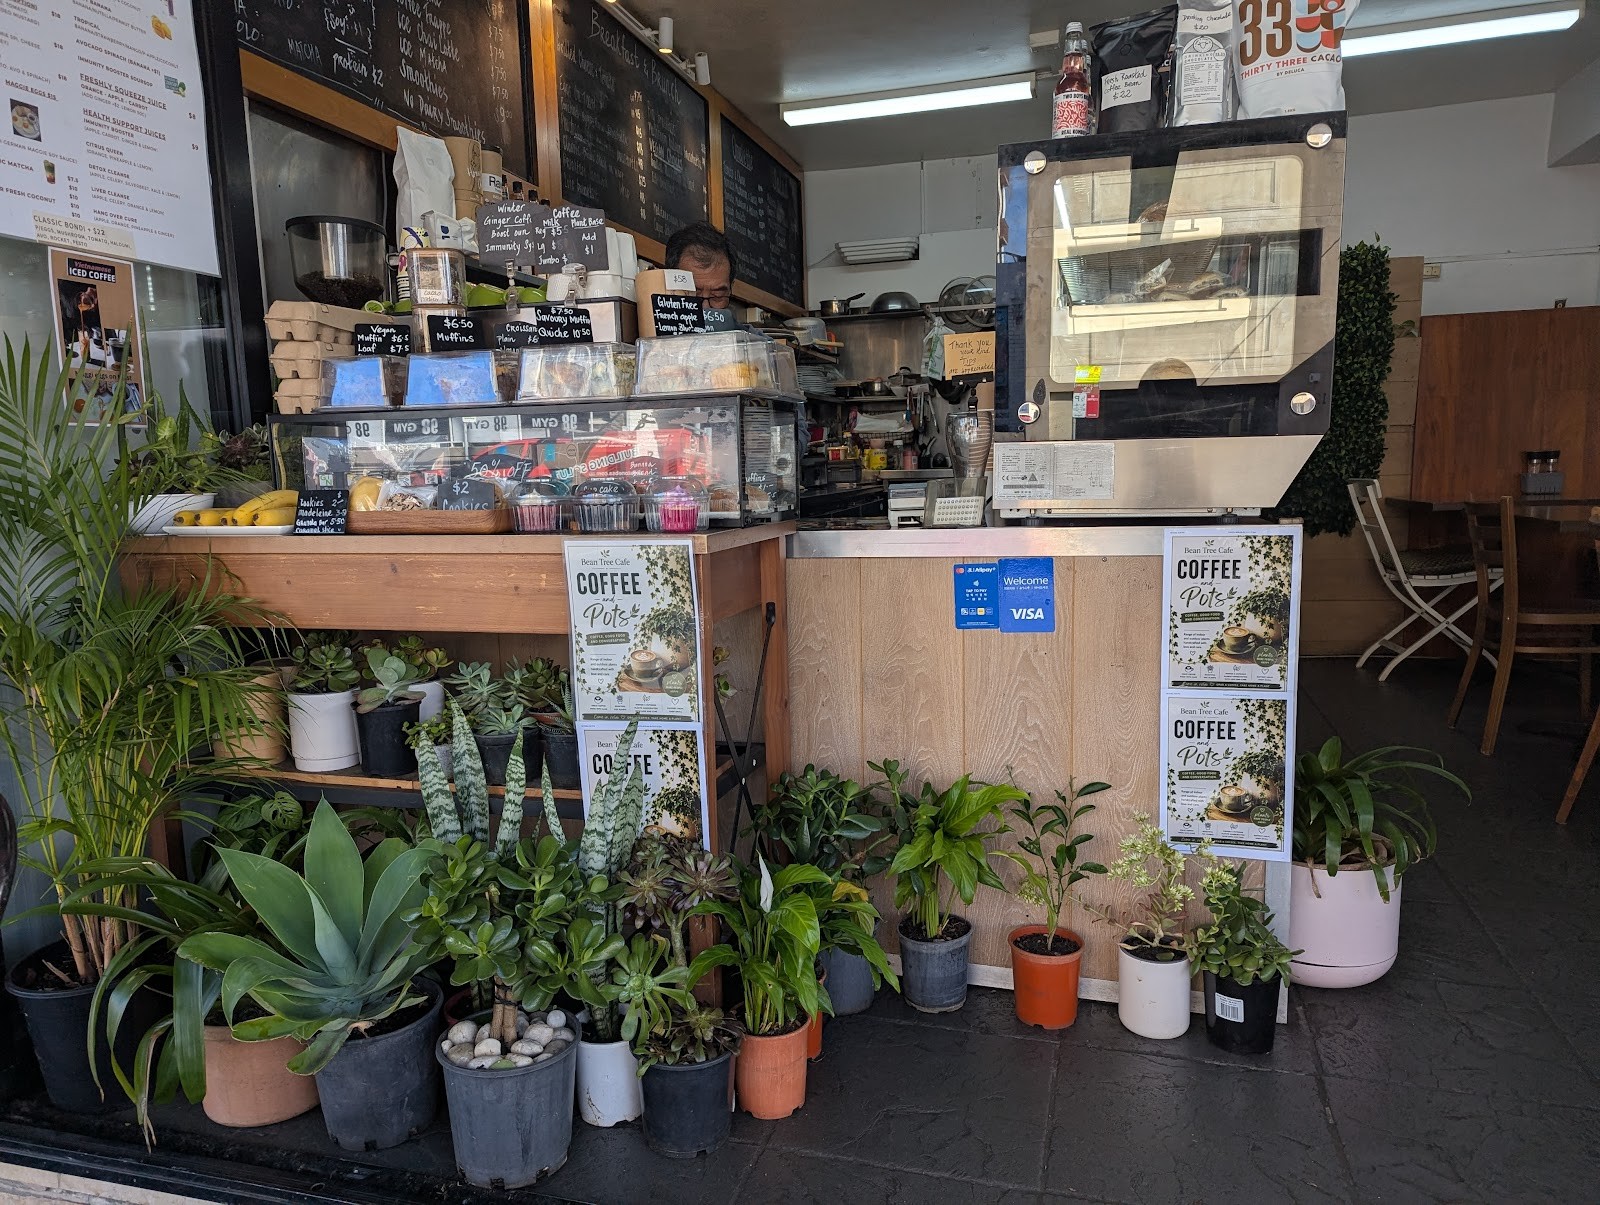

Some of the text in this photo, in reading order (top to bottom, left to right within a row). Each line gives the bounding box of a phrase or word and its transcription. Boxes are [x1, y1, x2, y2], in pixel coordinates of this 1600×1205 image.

[74, 15, 101, 31] TROPICAL
[1182, 12, 1232, 23] Drinking Chocolate
[1239, 0, 1292, 67] 33
[416, 21, 460, 63] Chai Latte
[75, 38, 127, 62] AVOCADO SPINACH
[288, 38, 323, 66] MATCHA
[588, 7, 640, 69] Breakfast
[651, 59, 682, 105] Brunch
[1184, 56, 1213, 64] CHOCOLATE
[1240, 53, 1342, 80] THIRTY THREE CACAO
[77, 55, 154, 88] IMMUNITY BOOSTER SOURSOP
[333, 48, 384, 87] protein $2
[1284, 67, 1305, 75] DELUCA
[399, 58, 449, 103] Smoothies
[1104, 69, 1148, 85] Fresh Roasted
[5, 79, 46, 98] MAGGIE EGGS
[80, 73, 167, 110] FRESHLY SQUEEZE JUICE
[1104, 84, 1122, 94] coffee
[1112, 89, 1132, 100] $22
[80, 84, 148, 111] ORANGE APPLE CARROT
[188, 112, 196, 120] $8
[403, 89, 486, 144] No Smoothies
[83, 108, 166, 141] HEALTH SUPPORT JUICES
[83, 118, 134, 138] IMMUNITY BOOSTER
[48, 151, 58, 159] SOY
[86, 141, 123, 156] CITRUS QUEEN
[7, 160, 34, 172] MATCHA
[88, 163, 130, 179] DETOX CLEANSE
[6, 187, 56, 204] FRESH COCONUT
[91, 187, 130, 200] LIVER CLEANSE
[93, 209, 108, 217] HANG
[497, 202, 526, 213] Winter
[553, 206, 581, 219] Coffee
[33, 215, 63, 227] CLASSIC
[93, 227, 105, 236] $22
[484, 216, 511, 230] Ginger
[542, 217, 605, 228] Milk Plant Base
[491, 229, 511, 238] Boost
[535, 226, 547, 238] Reg
[582, 233, 597, 241] Add
[72, 239, 88, 247] PESTO
[485, 241, 521, 256] Immunity
[537, 243, 594, 255] Lg $1
[74, 260, 111, 273] Vietnamese
[538, 255, 560, 266] Jumbo
[69, 267, 116, 282] ICED COFFEE
[673, 274, 688, 283] $58
[657, 296, 699, 310] Gluten Free
[536, 309, 591, 327] Savoury Muffin
[680, 312, 698, 325] apple
[370, 324, 397, 337] Vegan
[538, 326, 570, 338] Quiche
[357, 334, 383, 342] Muffin
[436, 332, 475, 343] Muffins
[949, 338, 973, 349] Thank
[358, 344, 377, 352] Loaf
[453, 481, 469, 495] $2
[599, 484, 619, 494] cake
[442, 498, 489, 510] Cookies
[298, 507, 333, 517] Madeleine
[296, 518, 317, 526] Granola
[581, 558, 630, 566] Bean Tree Cafe
[1177, 559, 1242, 580] COFFEE
[576, 572, 642, 595] COFFEE
[1003, 577, 1049, 585] Welcome
[602, 595, 616, 604] and
[1180, 586, 1227, 608] Pots
[583, 603, 631, 629] Pots
[1010, 608, 1045, 620] VISA
[1213, 708, 1229, 716] Cafe
[1174, 719, 1236, 740] COFFEE
[1176, 745, 1222, 768] Pots
